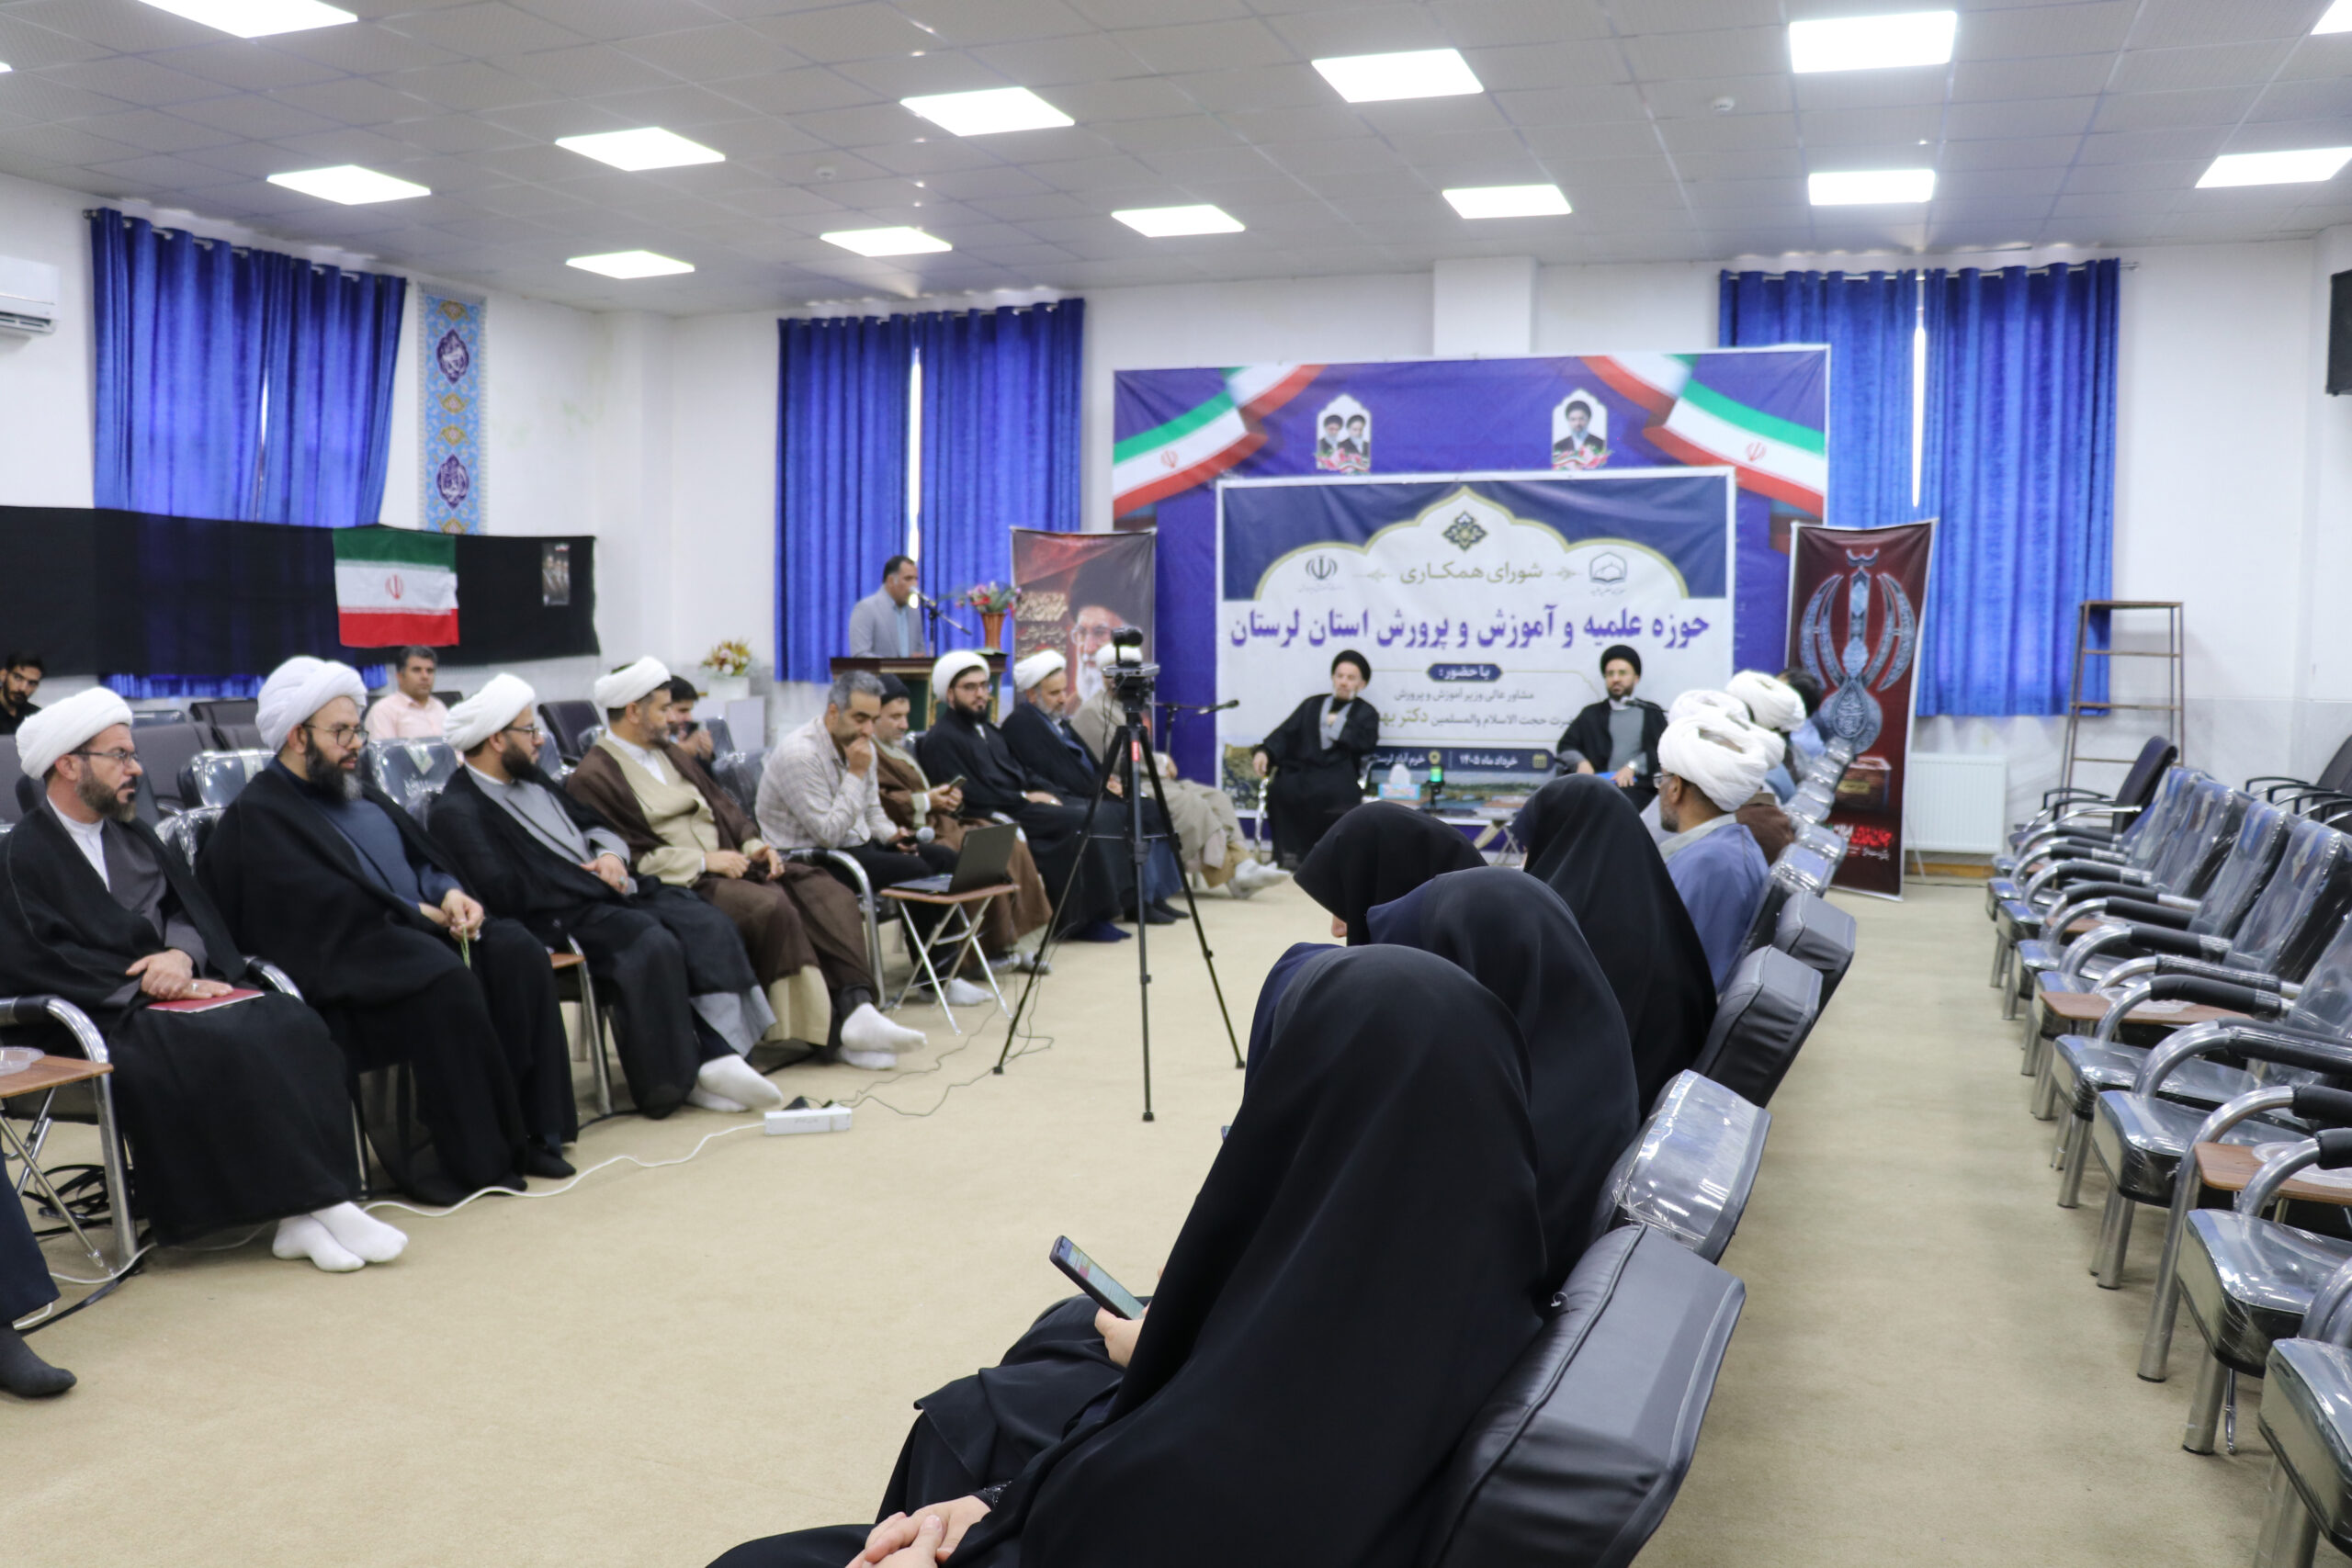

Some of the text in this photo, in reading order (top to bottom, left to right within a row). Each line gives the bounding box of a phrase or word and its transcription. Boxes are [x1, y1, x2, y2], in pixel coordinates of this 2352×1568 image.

[1399, 560, 1544, 585] شورای همکاری
[1230, 604, 1710, 649] حوزه علمیه و آموزش و پرورش استان لرستان
[1397, 706, 1428, 728] دکتر
